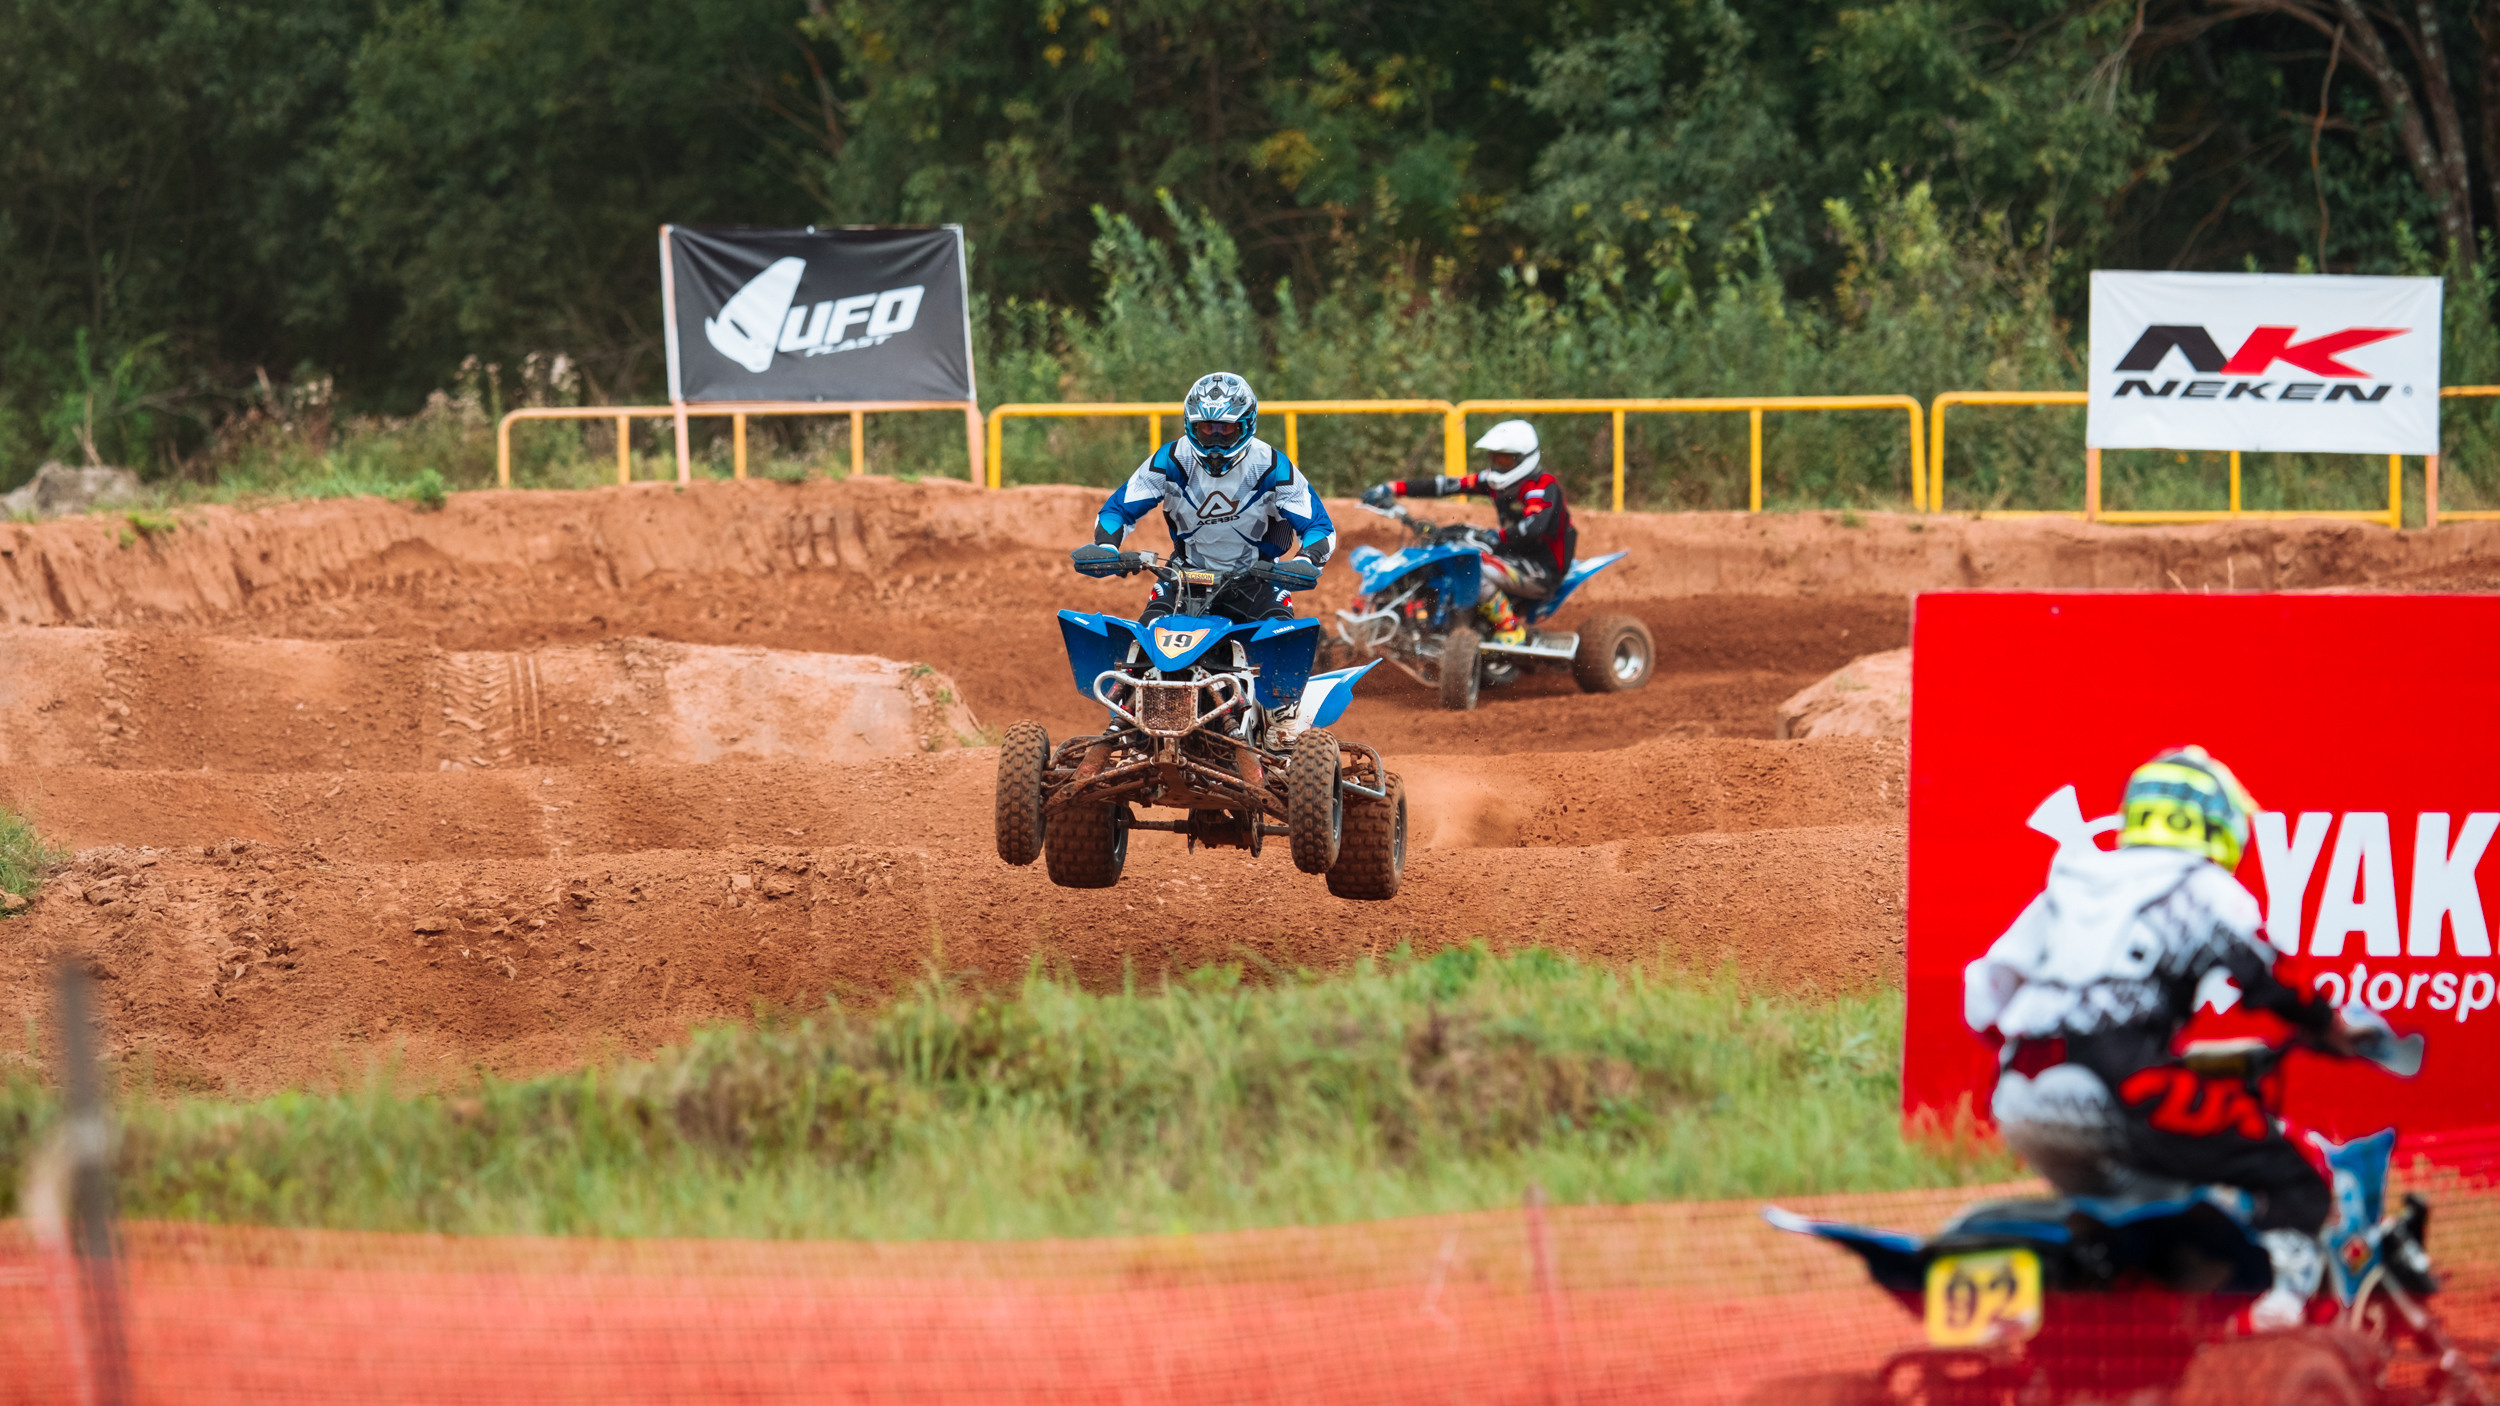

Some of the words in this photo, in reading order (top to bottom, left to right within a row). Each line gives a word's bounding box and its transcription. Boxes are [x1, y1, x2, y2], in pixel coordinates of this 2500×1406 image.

[776, 284, 925, 352] UFO
[2113, 380, 2393, 402] NEKEN
[1197, 514, 1241, 526] ACERBIS
[1161, 633, 1193, 648] 19
[2252, 811, 2500, 957] YAK
[1945, 1267, 2026, 1331] 92
